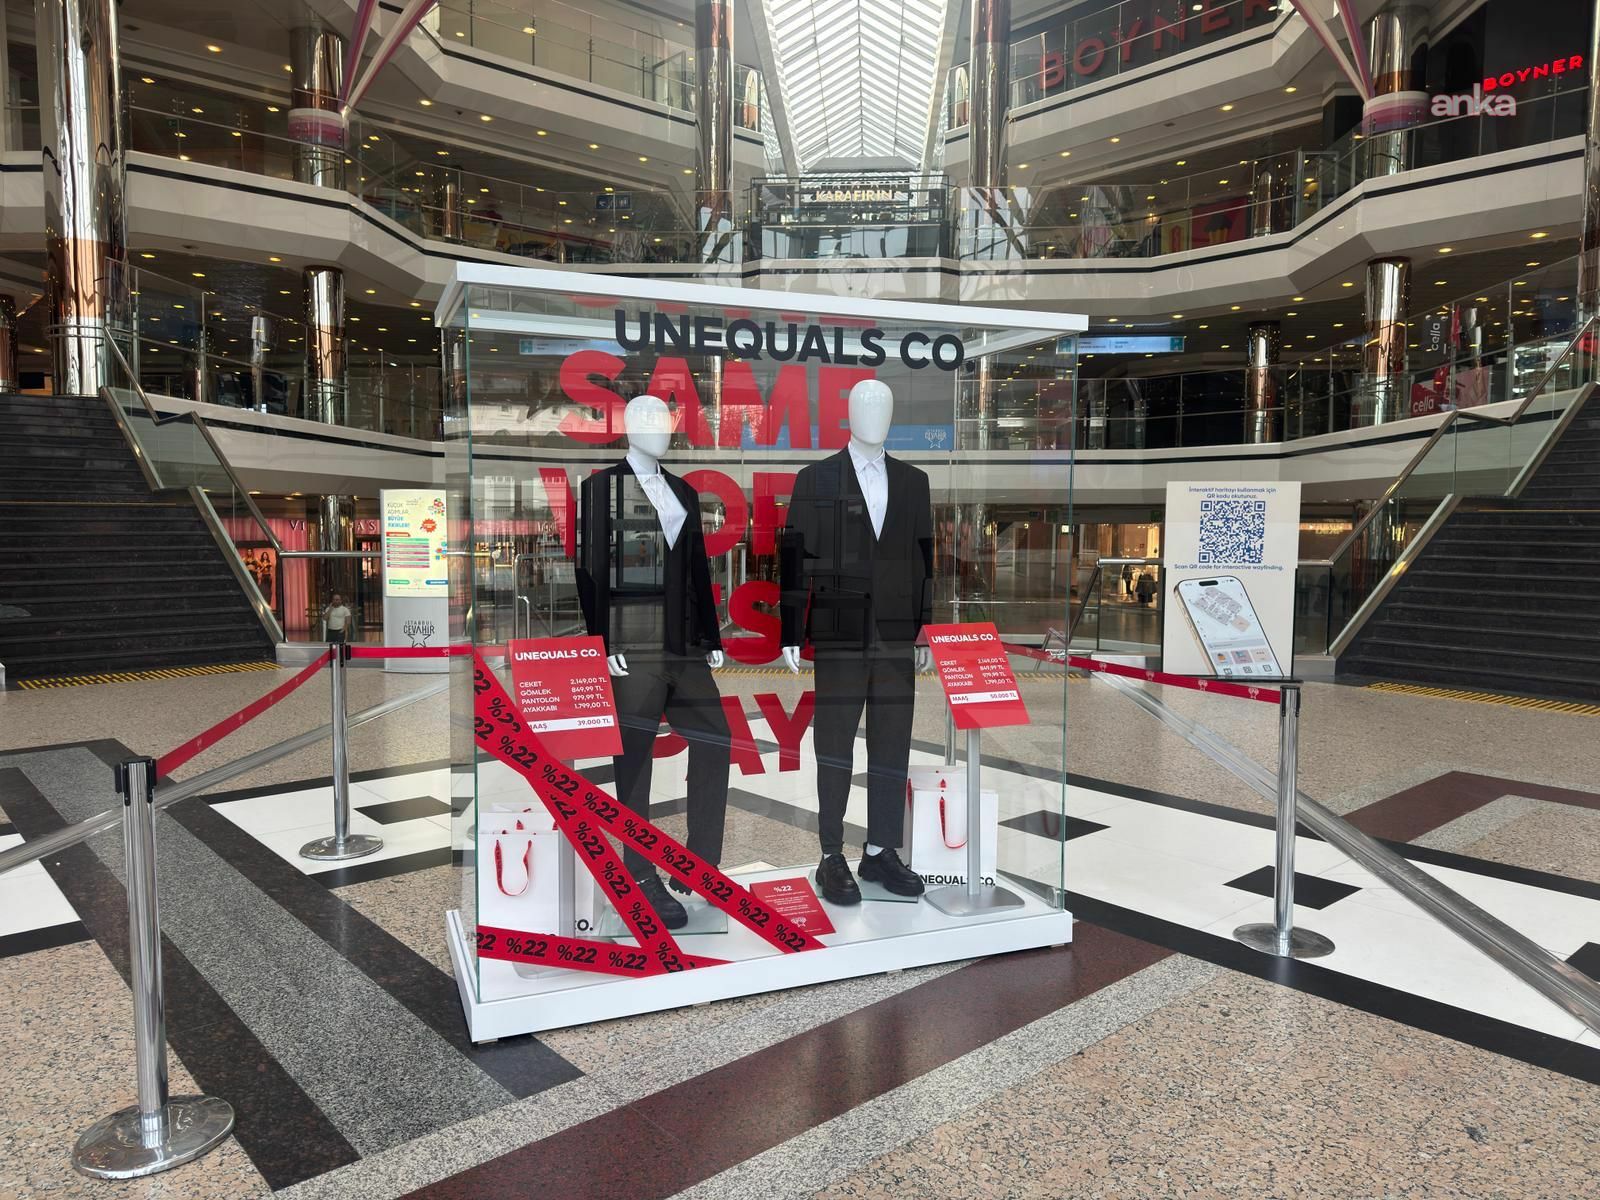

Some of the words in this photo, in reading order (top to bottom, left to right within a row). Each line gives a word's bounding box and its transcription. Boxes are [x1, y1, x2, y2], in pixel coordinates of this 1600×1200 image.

[1482, 55, 1584, 92] BOYNER
[614, 309, 887, 367] UNEQUALS
[899, 331, 976, 372] CO.
[557, 349, 877, 450] SAME
[1412, 396, 1434, 413] cella
[931, 633, 979, 643] UNEQUALS
[979, 633, 997, 641] CO.
[514, 649, 578, 661] UNEQUALS
[580, 648, 601, 658] CO.
[570, 677, 598, 685] 2.149,00
[520, 688, 552, 697] GÖMLEK
[521, 696, 560, 705] PANTOLON
[523, 705, 558, 713] AYAKKABI
[574, 702, 601, 710] 1.799,00
[577, 719, 601, 727] 39.000
[498, 735, 538, 770] %22
[542, 764, 580, 797] %22
[582, 791, 620, 825] %22
[622, 819, 658, 851] %22
[660, 845, 696, 877] %22
[699, 872, 734, 903] %22
[737, 898, 770, 929] %22
[774, 923, 806, 953] %22
[574, 821, 605, 861] %22
[601, 861, 631, 899] %22
[627, 902, 658, 939] %22
[920, 874, 968, 886] NEQUAL
[773, 885, 793, 893] %22
[575, 918, 594, 931] O.
[505, 937, 549, 958] %22
[556, 944, 598, 964] %22
[608, 951, 648, 971] %22
